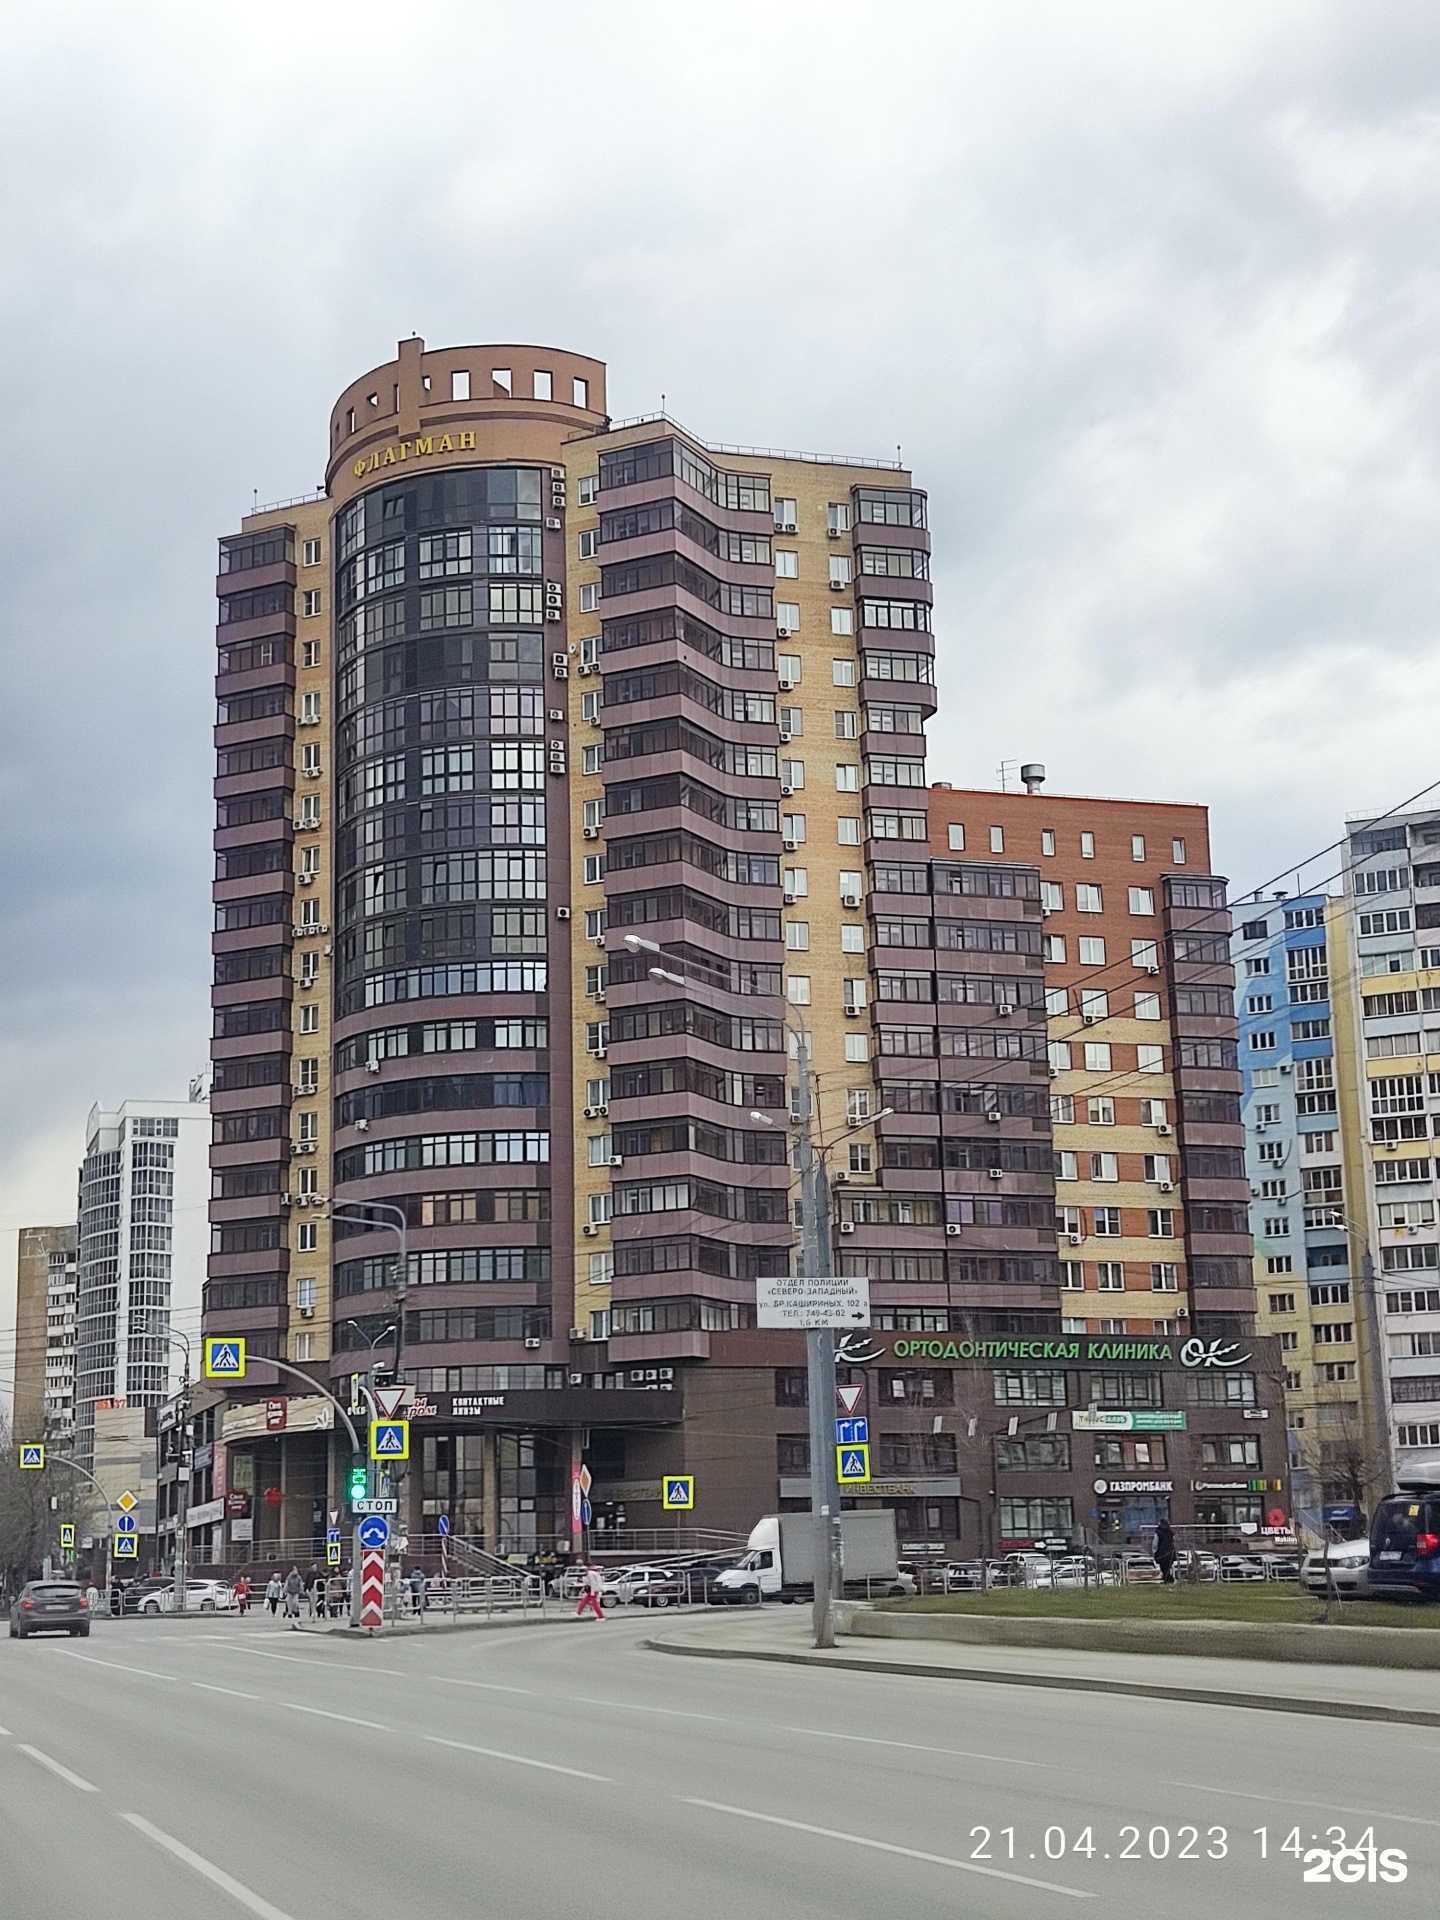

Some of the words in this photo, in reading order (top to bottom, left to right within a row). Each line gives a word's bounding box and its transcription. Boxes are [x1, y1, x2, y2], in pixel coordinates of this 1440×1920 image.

[353, 431, 477, 477] ФЛАГМАН
[776, 1279, 804, 1287] ОТДЕЛ
[807, 1279, 849, 1288] ПОЛИЦИИ
[893, 1339, 1080, 1360] ОРТОДОНТИЧЕСКАЯ
[1087, 1342, 1173, 1361] КЛИНИКА
[451, 1396, 505, 1407] КОНТАКТНЫЕ
[451, 1406, 482, 1416] ЛИНЗЫ
[1109, 1480, 1174, 1492] ГАЗПРОМБАНК
[357, 1500, 392, 1511] СТОП
[1260, 1526, 1295, 1536] ЦВЕТЫ
